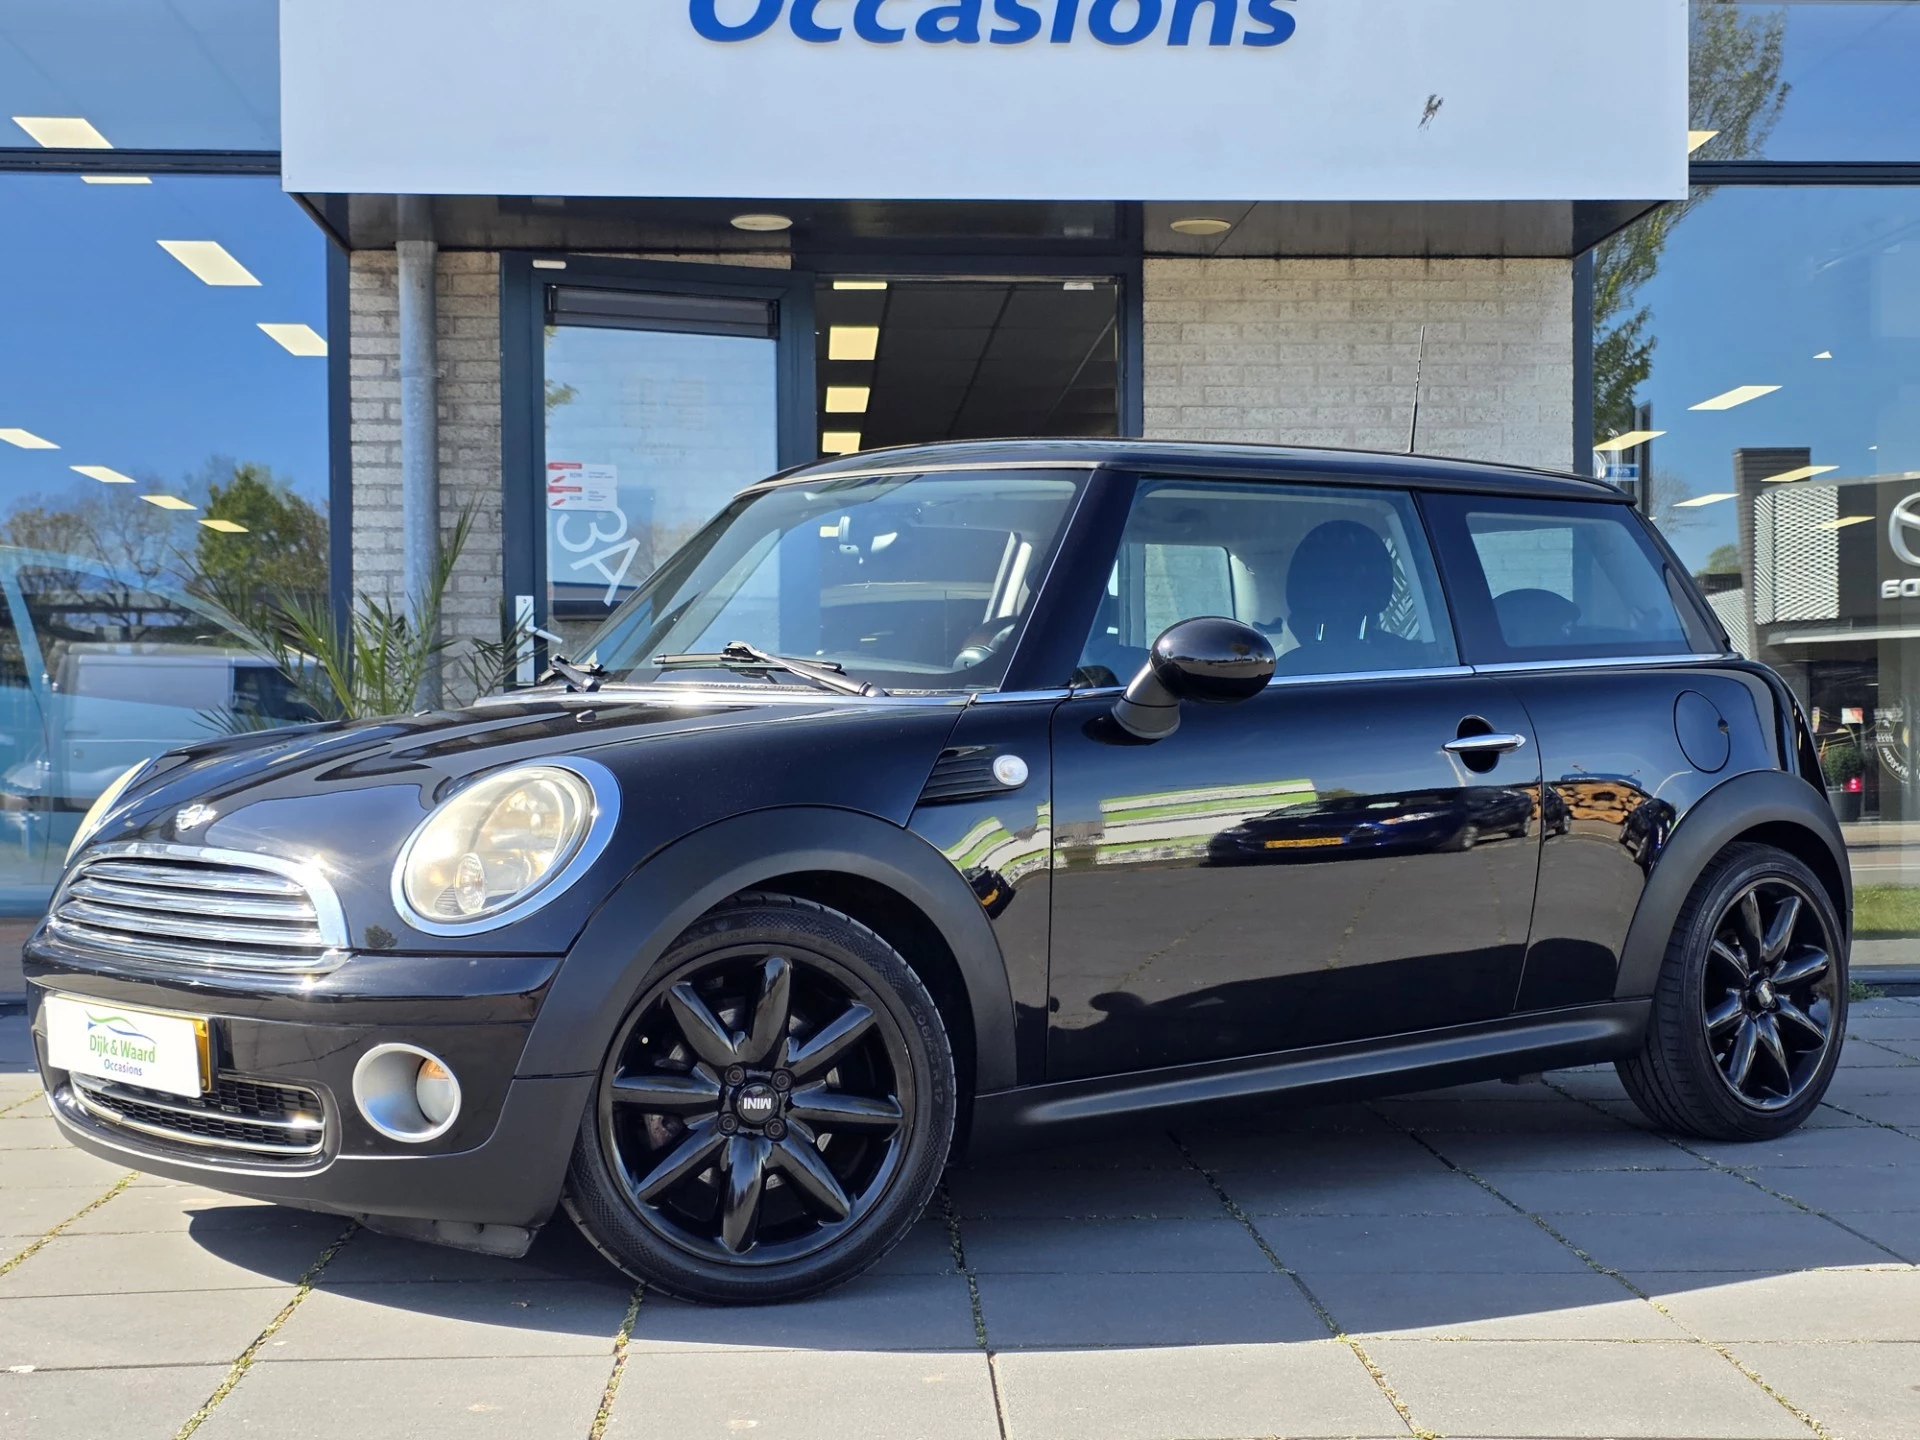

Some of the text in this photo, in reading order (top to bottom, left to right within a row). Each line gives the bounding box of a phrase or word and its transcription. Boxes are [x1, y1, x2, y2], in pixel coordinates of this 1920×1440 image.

[689, 0, 1296, 46] Occasions
[89, 1034, 156, 1063] Dijk & Waard
[103, 1058, 143, 1076] Occasions
[743, 1097, 772, 1110] MINI
